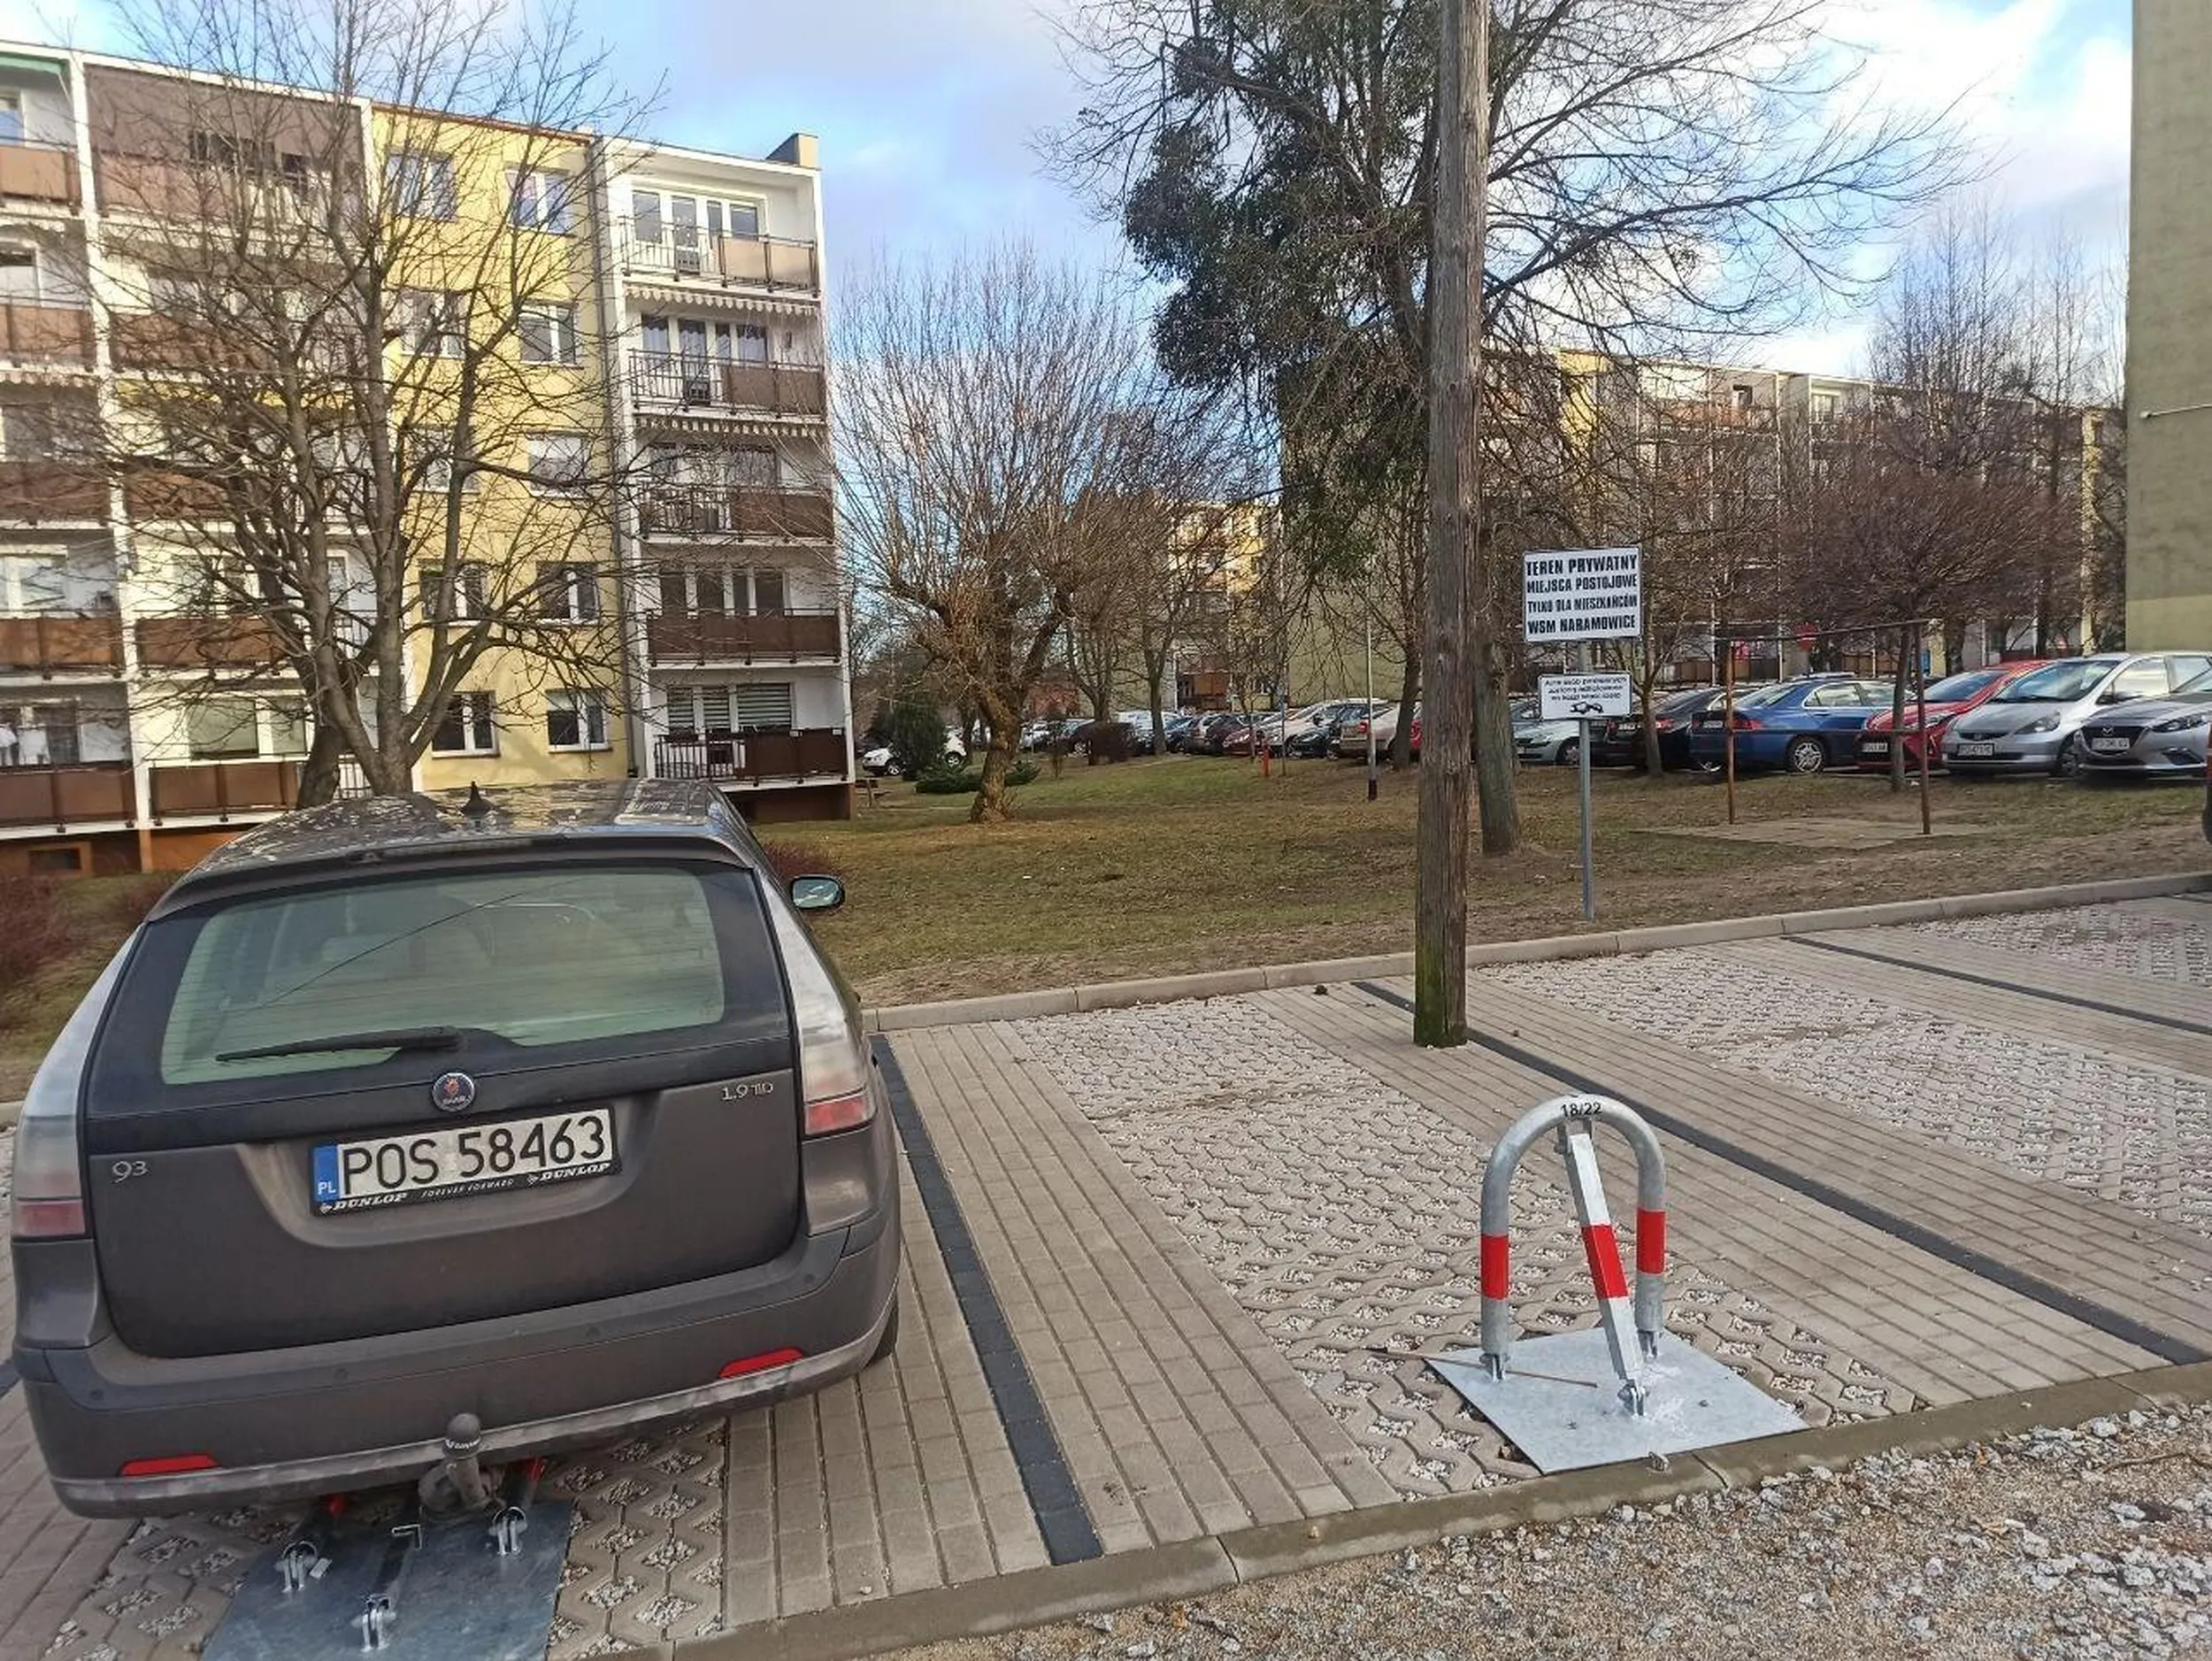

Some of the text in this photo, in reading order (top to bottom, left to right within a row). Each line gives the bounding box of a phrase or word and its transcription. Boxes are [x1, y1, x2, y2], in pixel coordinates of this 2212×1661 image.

[1526, 554, 1638, 576] TEREN PRYWATNY
[1527, 573, 1638, 593] MIEJSCA POSTOJOWE
[1528, 614, 1636, 634] WSM NARAMOWICE
[722, 1084, 749, 1101] 1.9
[1561, 1101, 1602, 1118] 18/22
[342, 1115, 606, 1196] POS 58463
[318, 1180, 337, 1196] PL
[333, 1192, 408, 1211] DUNLOP
[539, 1163, 611, 1182] DUNLOP
